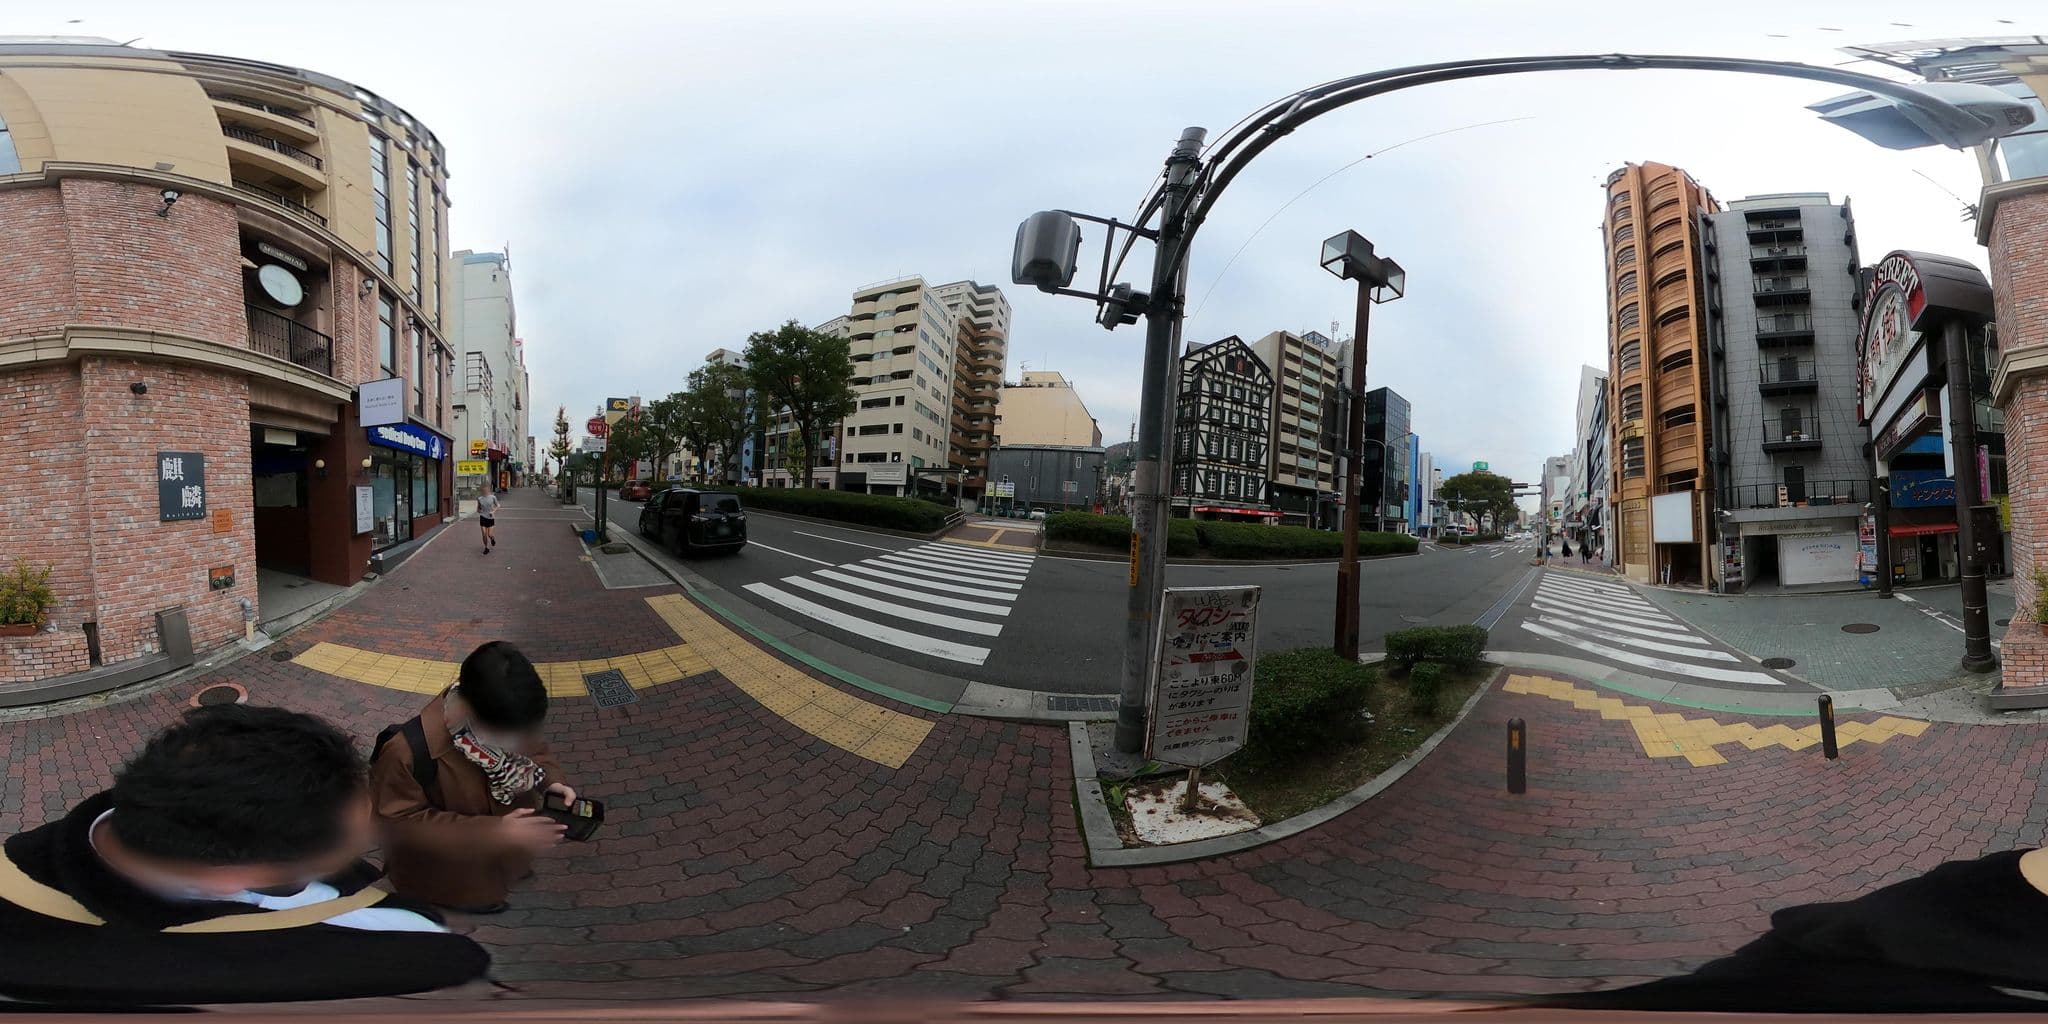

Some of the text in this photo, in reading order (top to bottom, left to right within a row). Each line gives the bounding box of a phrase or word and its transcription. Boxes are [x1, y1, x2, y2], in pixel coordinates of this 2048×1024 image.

[1877, 256, 1919, 300] STREET
[1177, 607, 1247, 628] タクシー
[1168, 683, 1241, 699] にタクシーのりば
[1168, 697, 1216, 710] があります
[1166, 713, 1238, 728] ここからご乗車は
[1166, 726, 1210, 738] できません
[1163, 736, 1235, 751] 兵庫県タクシー協会
